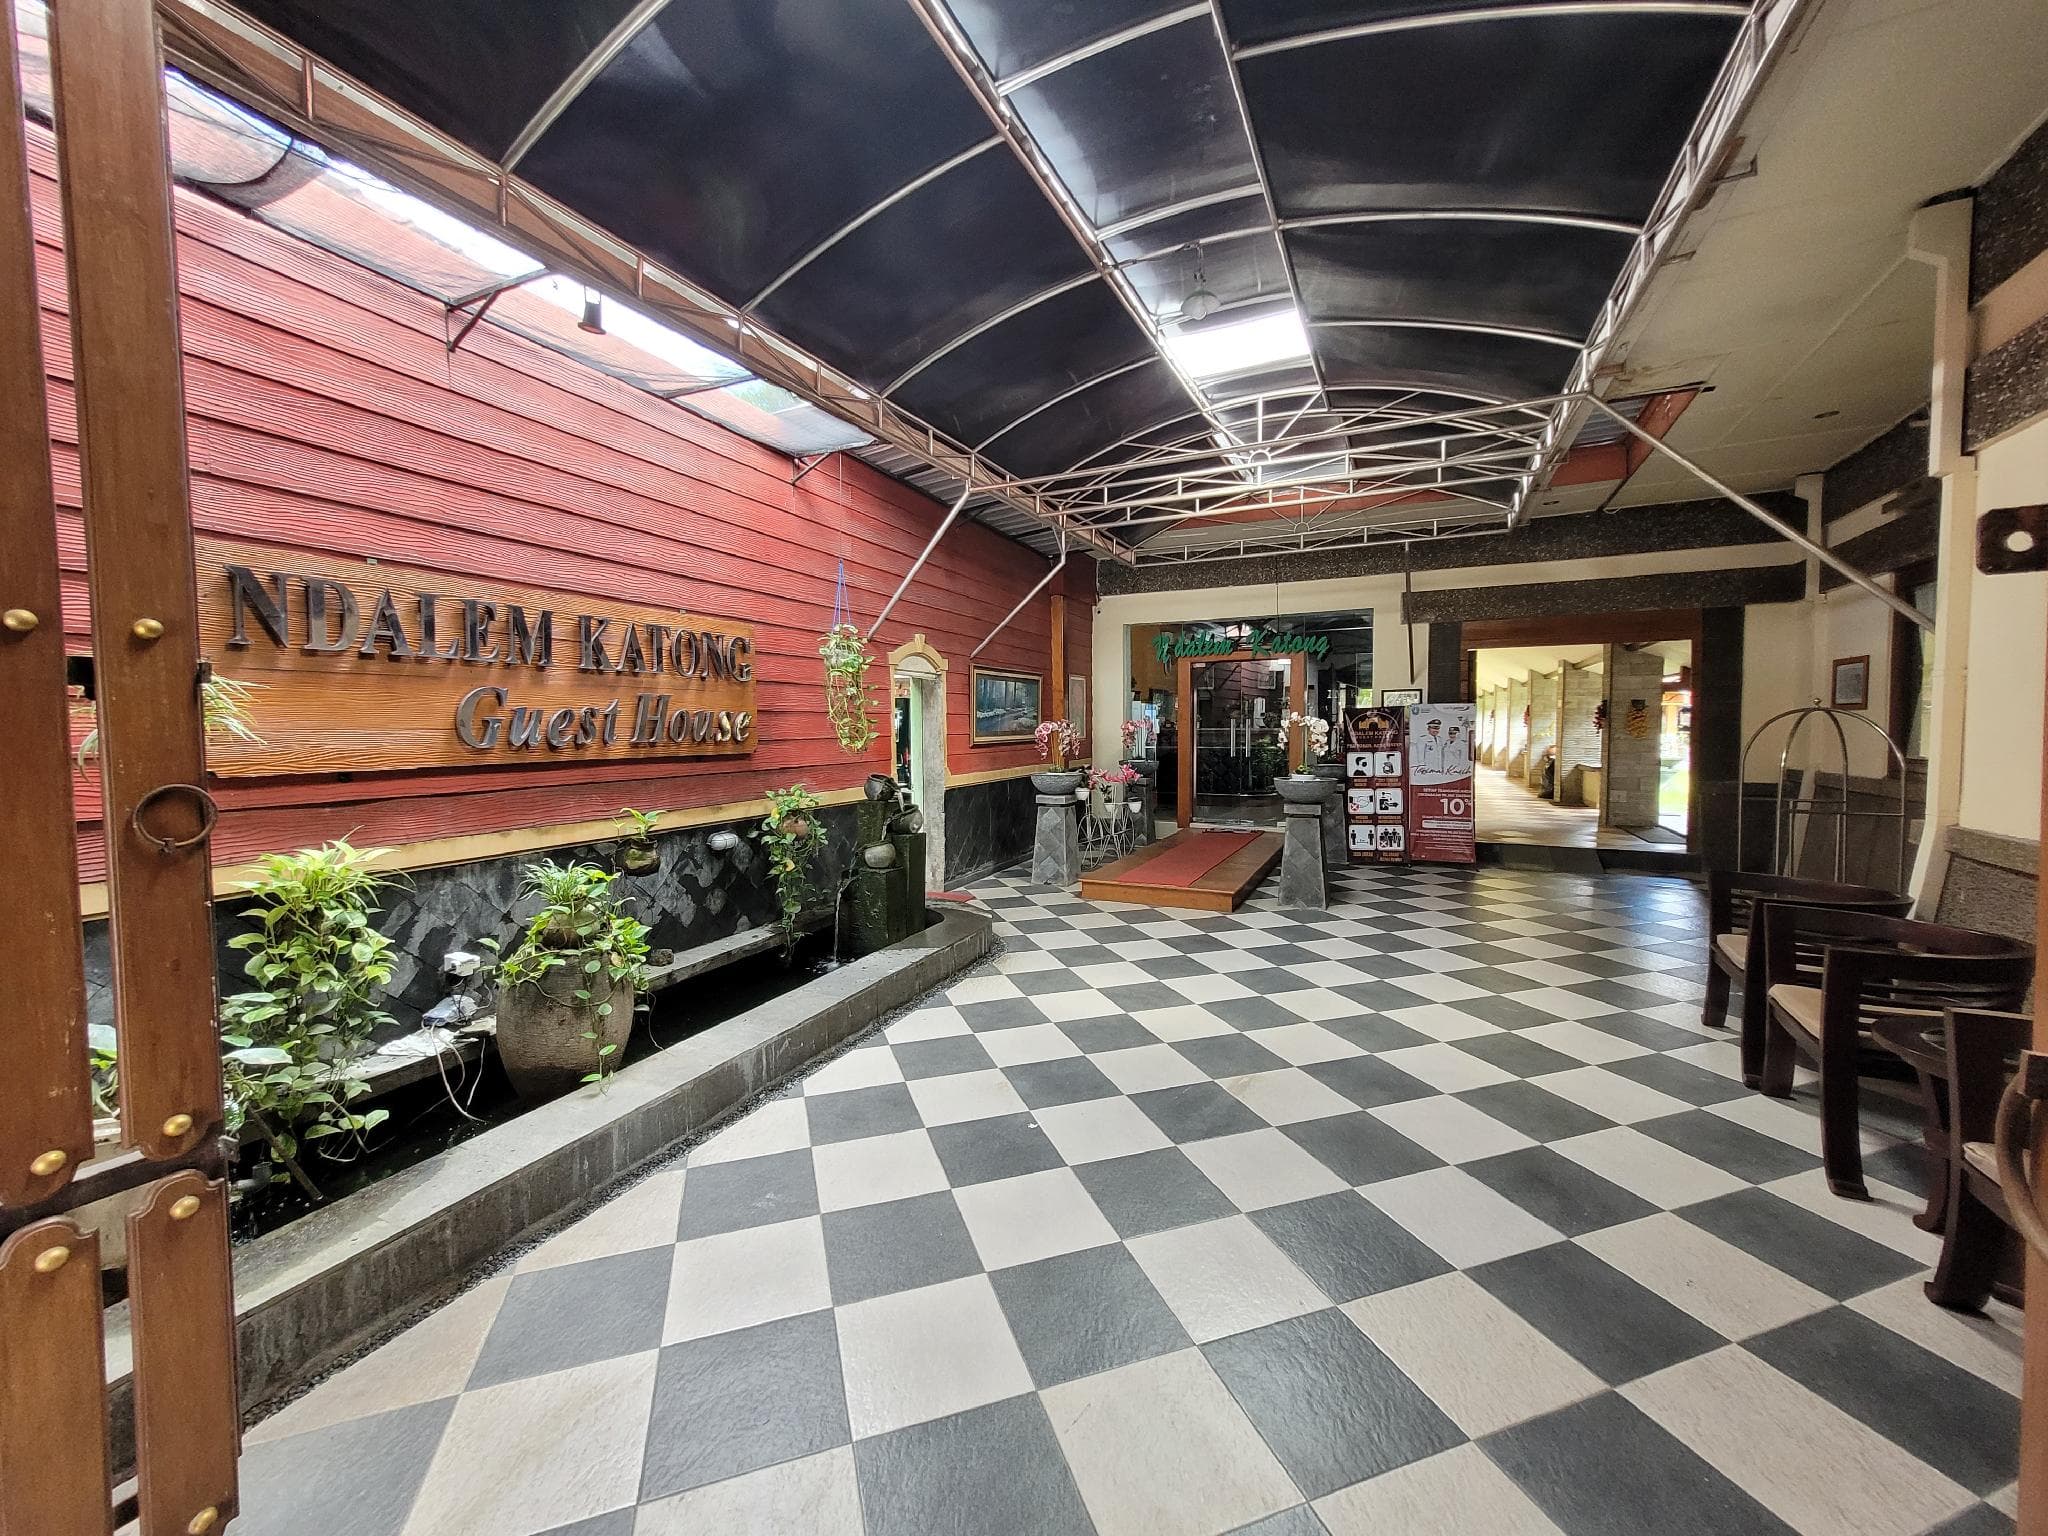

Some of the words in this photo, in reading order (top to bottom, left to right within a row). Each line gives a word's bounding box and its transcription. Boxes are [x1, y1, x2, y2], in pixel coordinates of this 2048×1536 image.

[223, 563, 555, 668] NDALEM
[577, 614, 752, 683] KATONG
[455, 685, 623, 751] Guest
[630, 692, 752, 748] House
